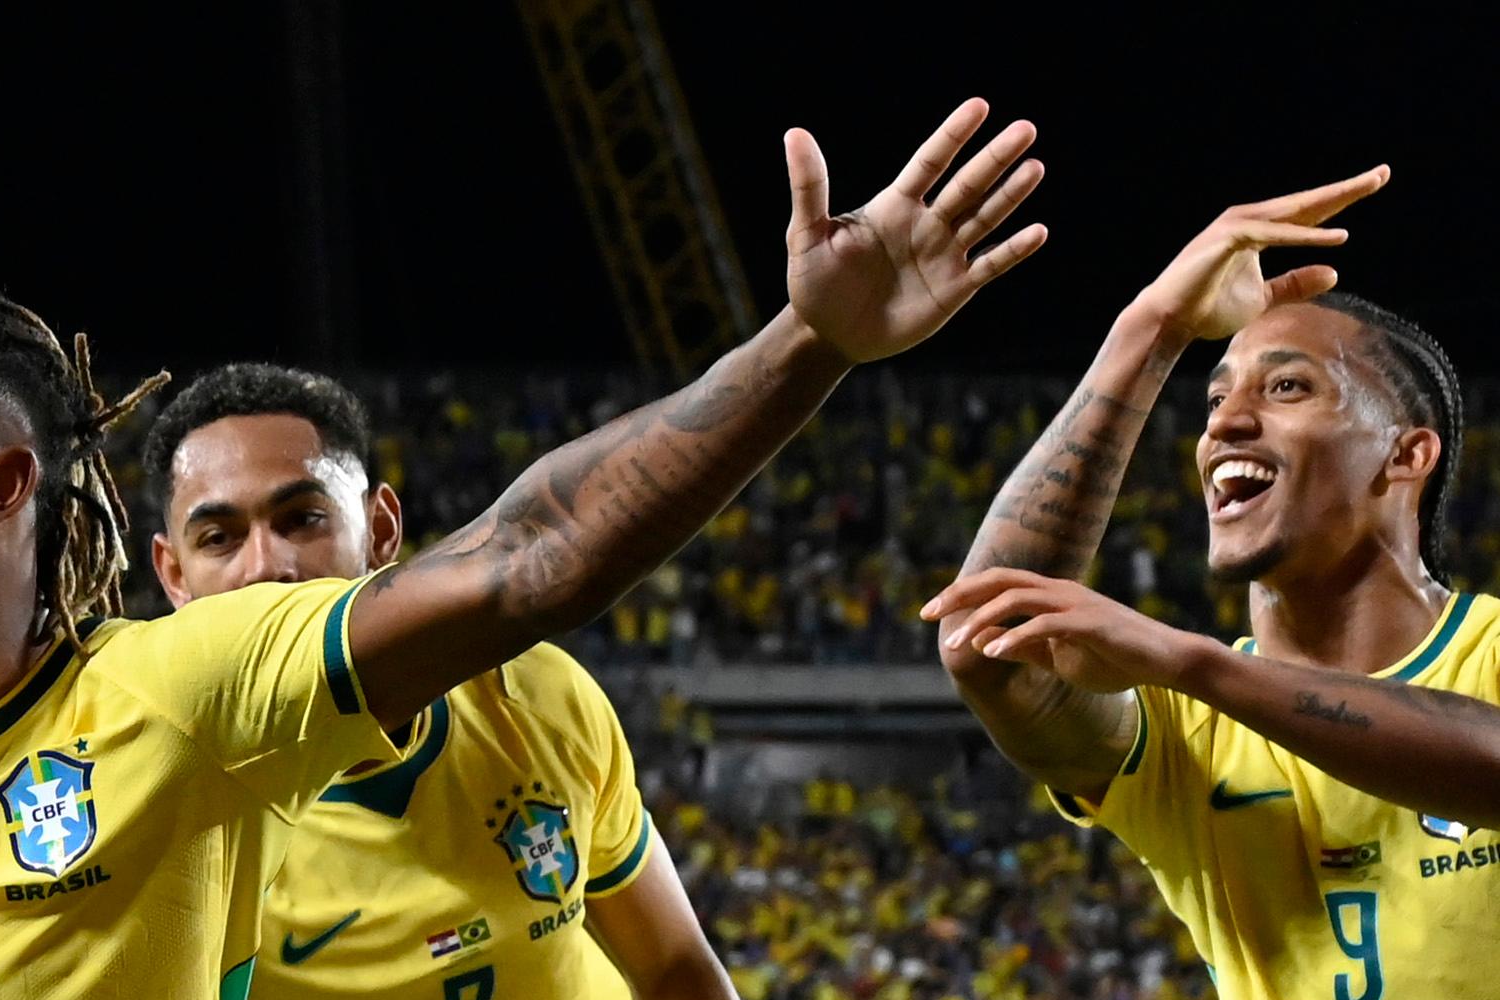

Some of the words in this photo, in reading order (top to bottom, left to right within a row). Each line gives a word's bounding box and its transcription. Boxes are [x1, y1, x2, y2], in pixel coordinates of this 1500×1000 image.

[31, 800, 67, 824] CBF
[528, 838, 555, 860] CBF
[4, 864, 113, 902] BRASIL
